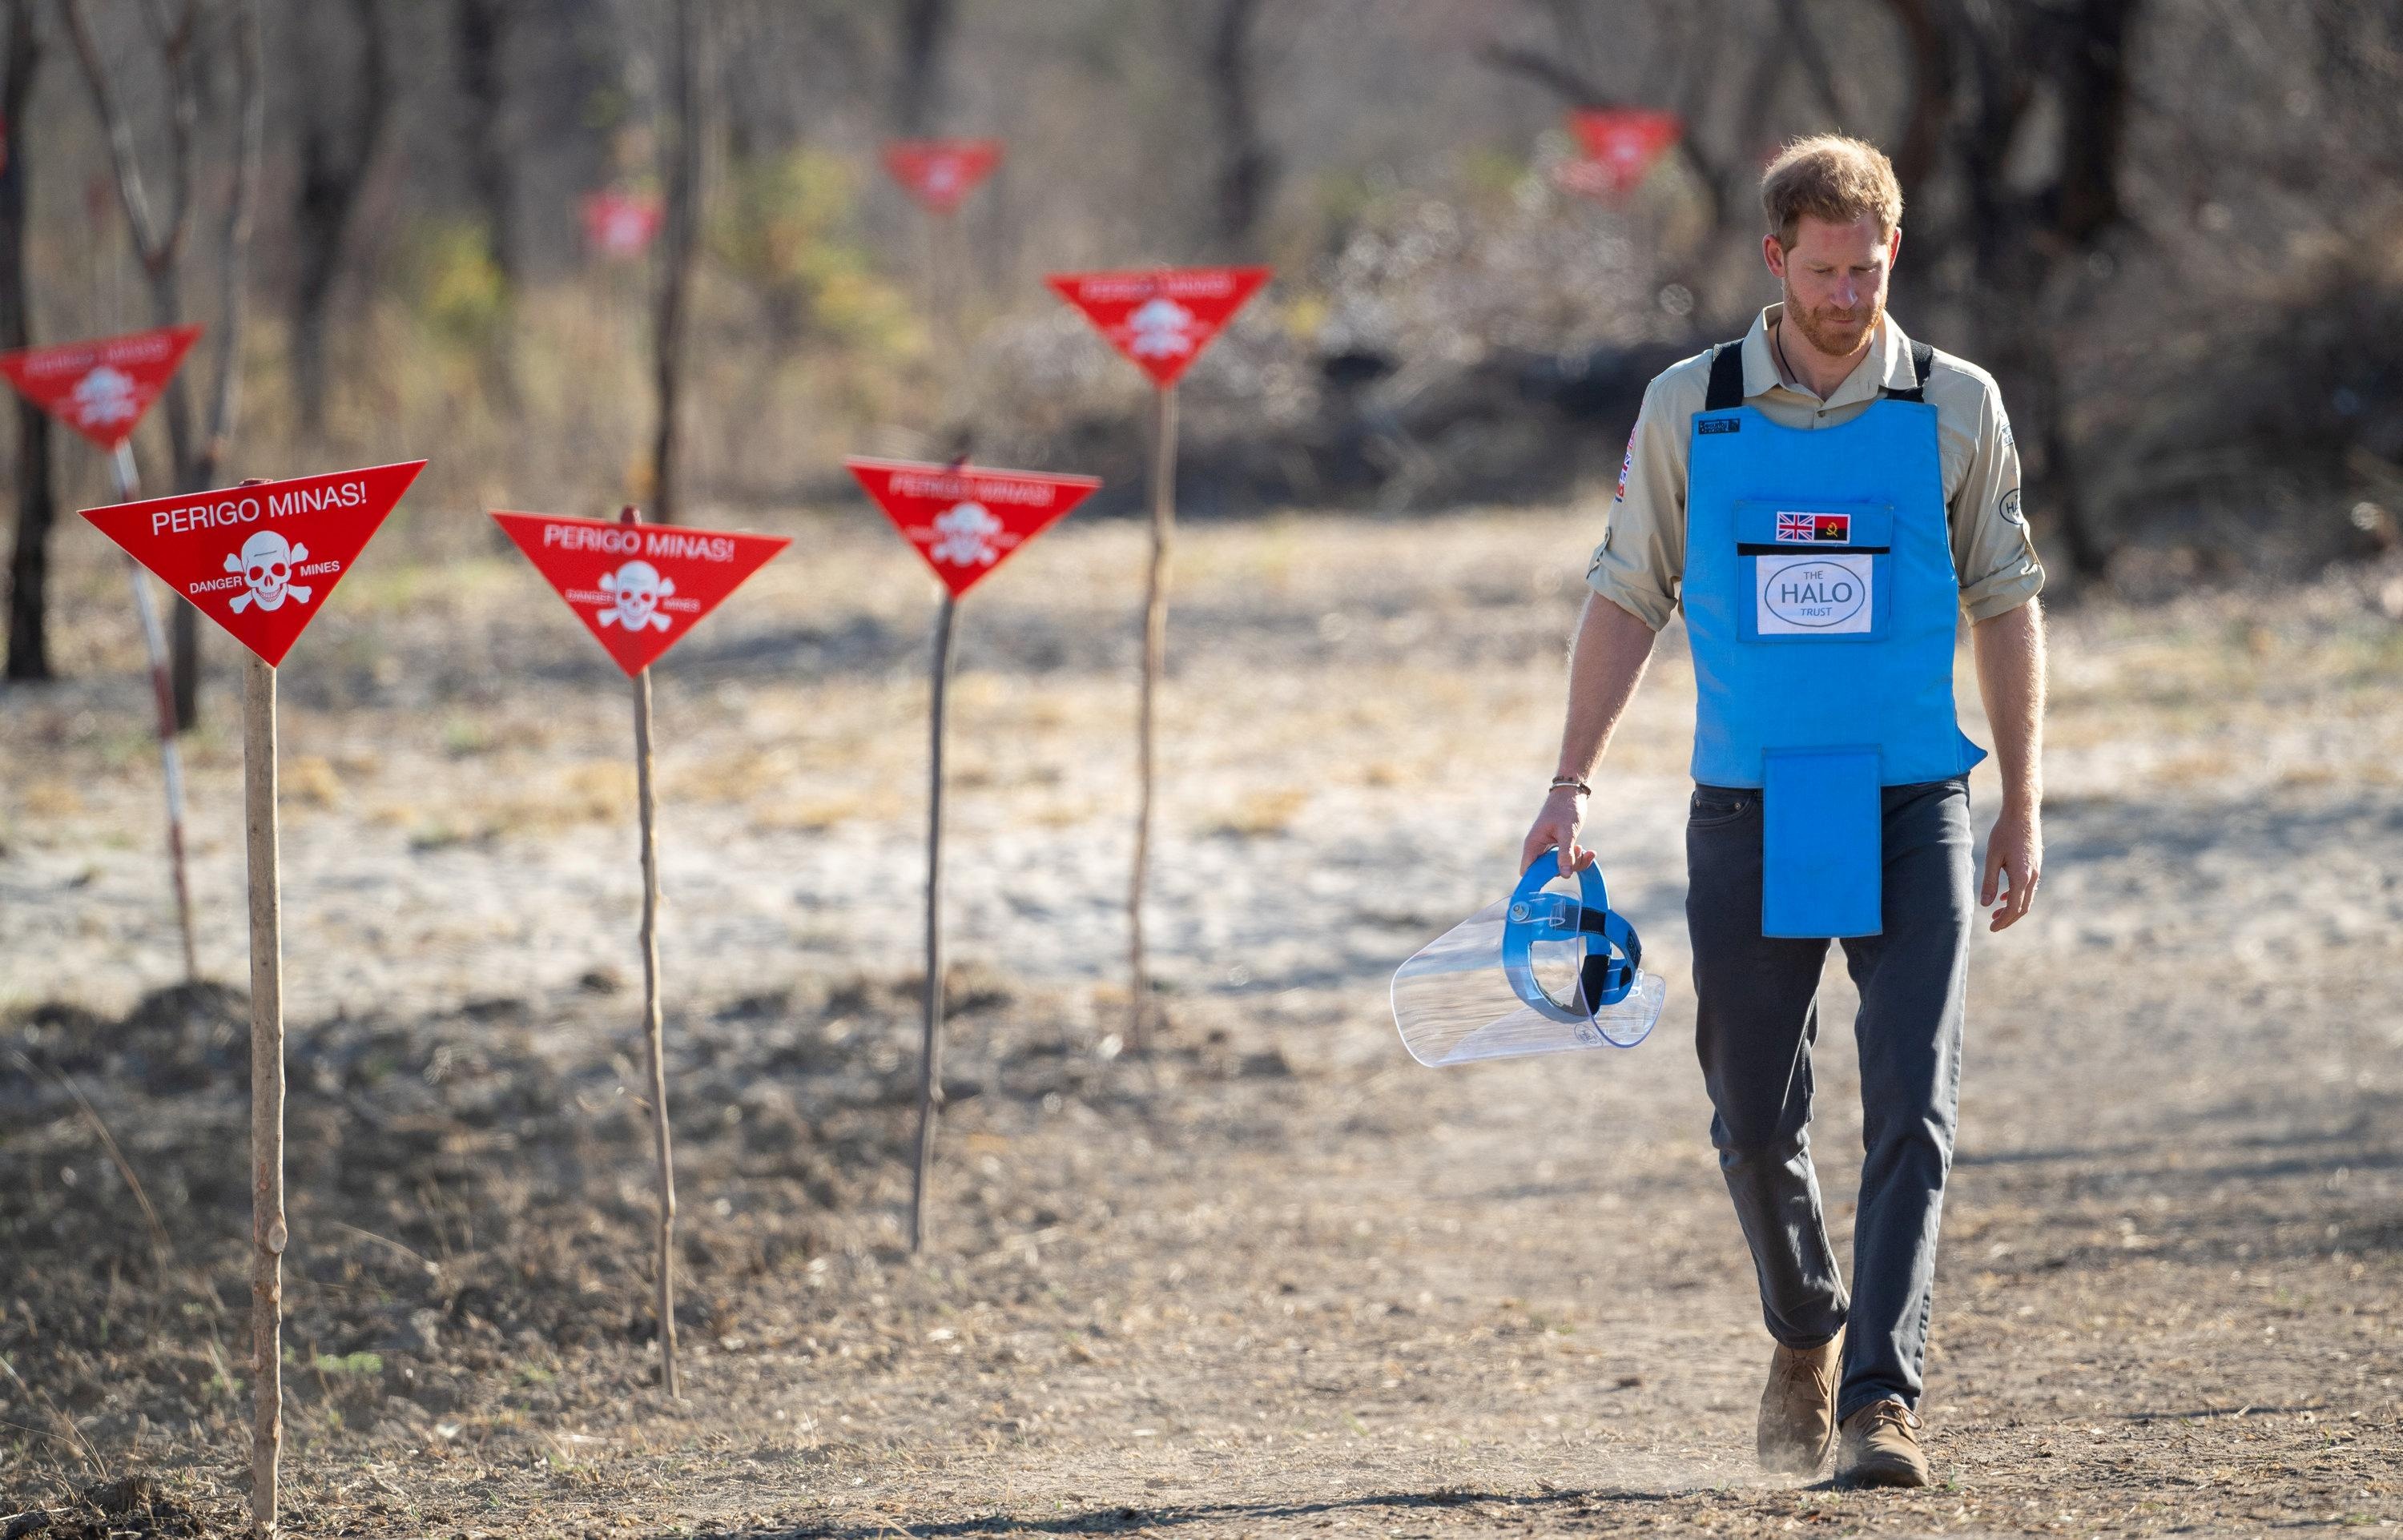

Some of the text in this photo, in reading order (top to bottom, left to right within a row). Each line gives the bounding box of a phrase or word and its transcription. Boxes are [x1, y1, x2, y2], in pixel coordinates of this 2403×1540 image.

[151, 481, 367, 536] PERIGO MINAS!
[544, 525, 735, 562] PERIGO MINAS!
[190, 561, 340, 594] DANGER MINES
[1803, 570, 1824, 580] THE
[1781, 582, 1853, 604] HALO
[1801, 607, 1833, 617] TRUST
